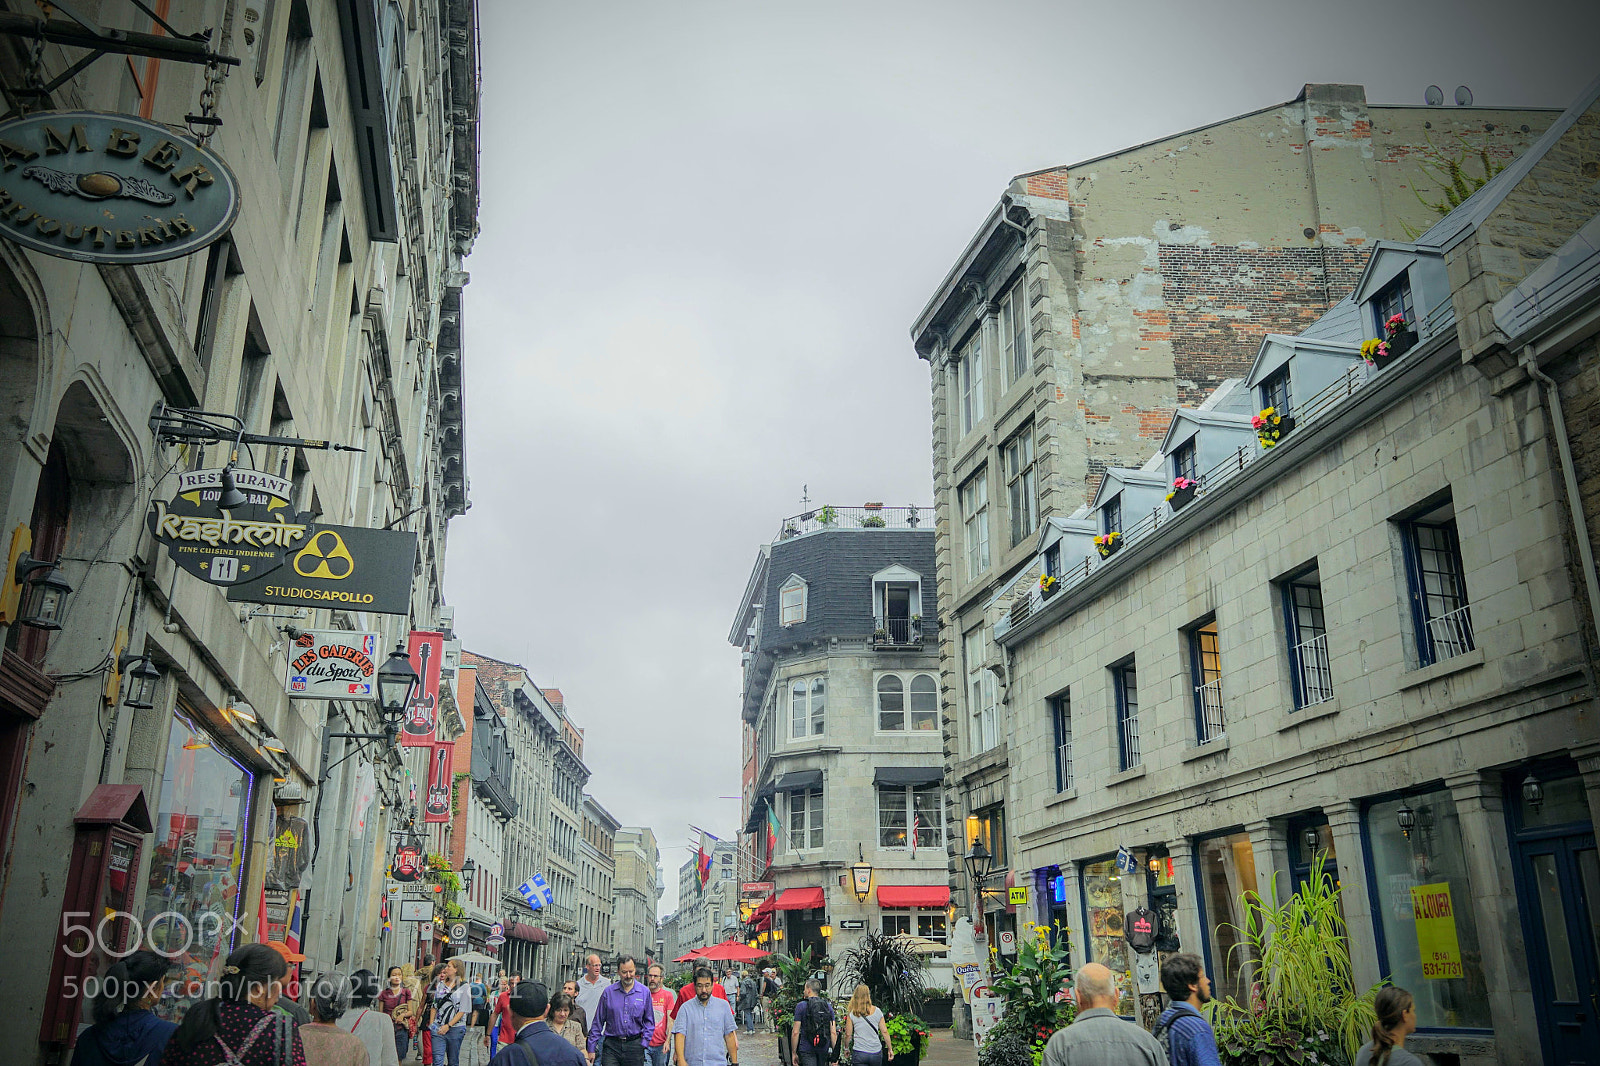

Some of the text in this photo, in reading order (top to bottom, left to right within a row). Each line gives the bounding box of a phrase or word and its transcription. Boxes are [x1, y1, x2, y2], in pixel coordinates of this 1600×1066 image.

[0, 123, 215, 200] AMBER
[186, 473, 288, 493] RESTURANT
[249, 494, 268, 505] BAR
[155, 501, 307, 549] kashmir
[200, 548, 234, 556] CUISINE
[235, 550, 275, 558] INDIENNE
[292, 644, 374, 678] LES GALERIES
[306, 662, 362, 682] du Sport
[1010, 891, 1025, 901] ATM
[1421, 893, 1452, 918] LOUER
[1432, 952, 1450, 961] (514)
[1423, 962, 1462, 976] 531-7731
